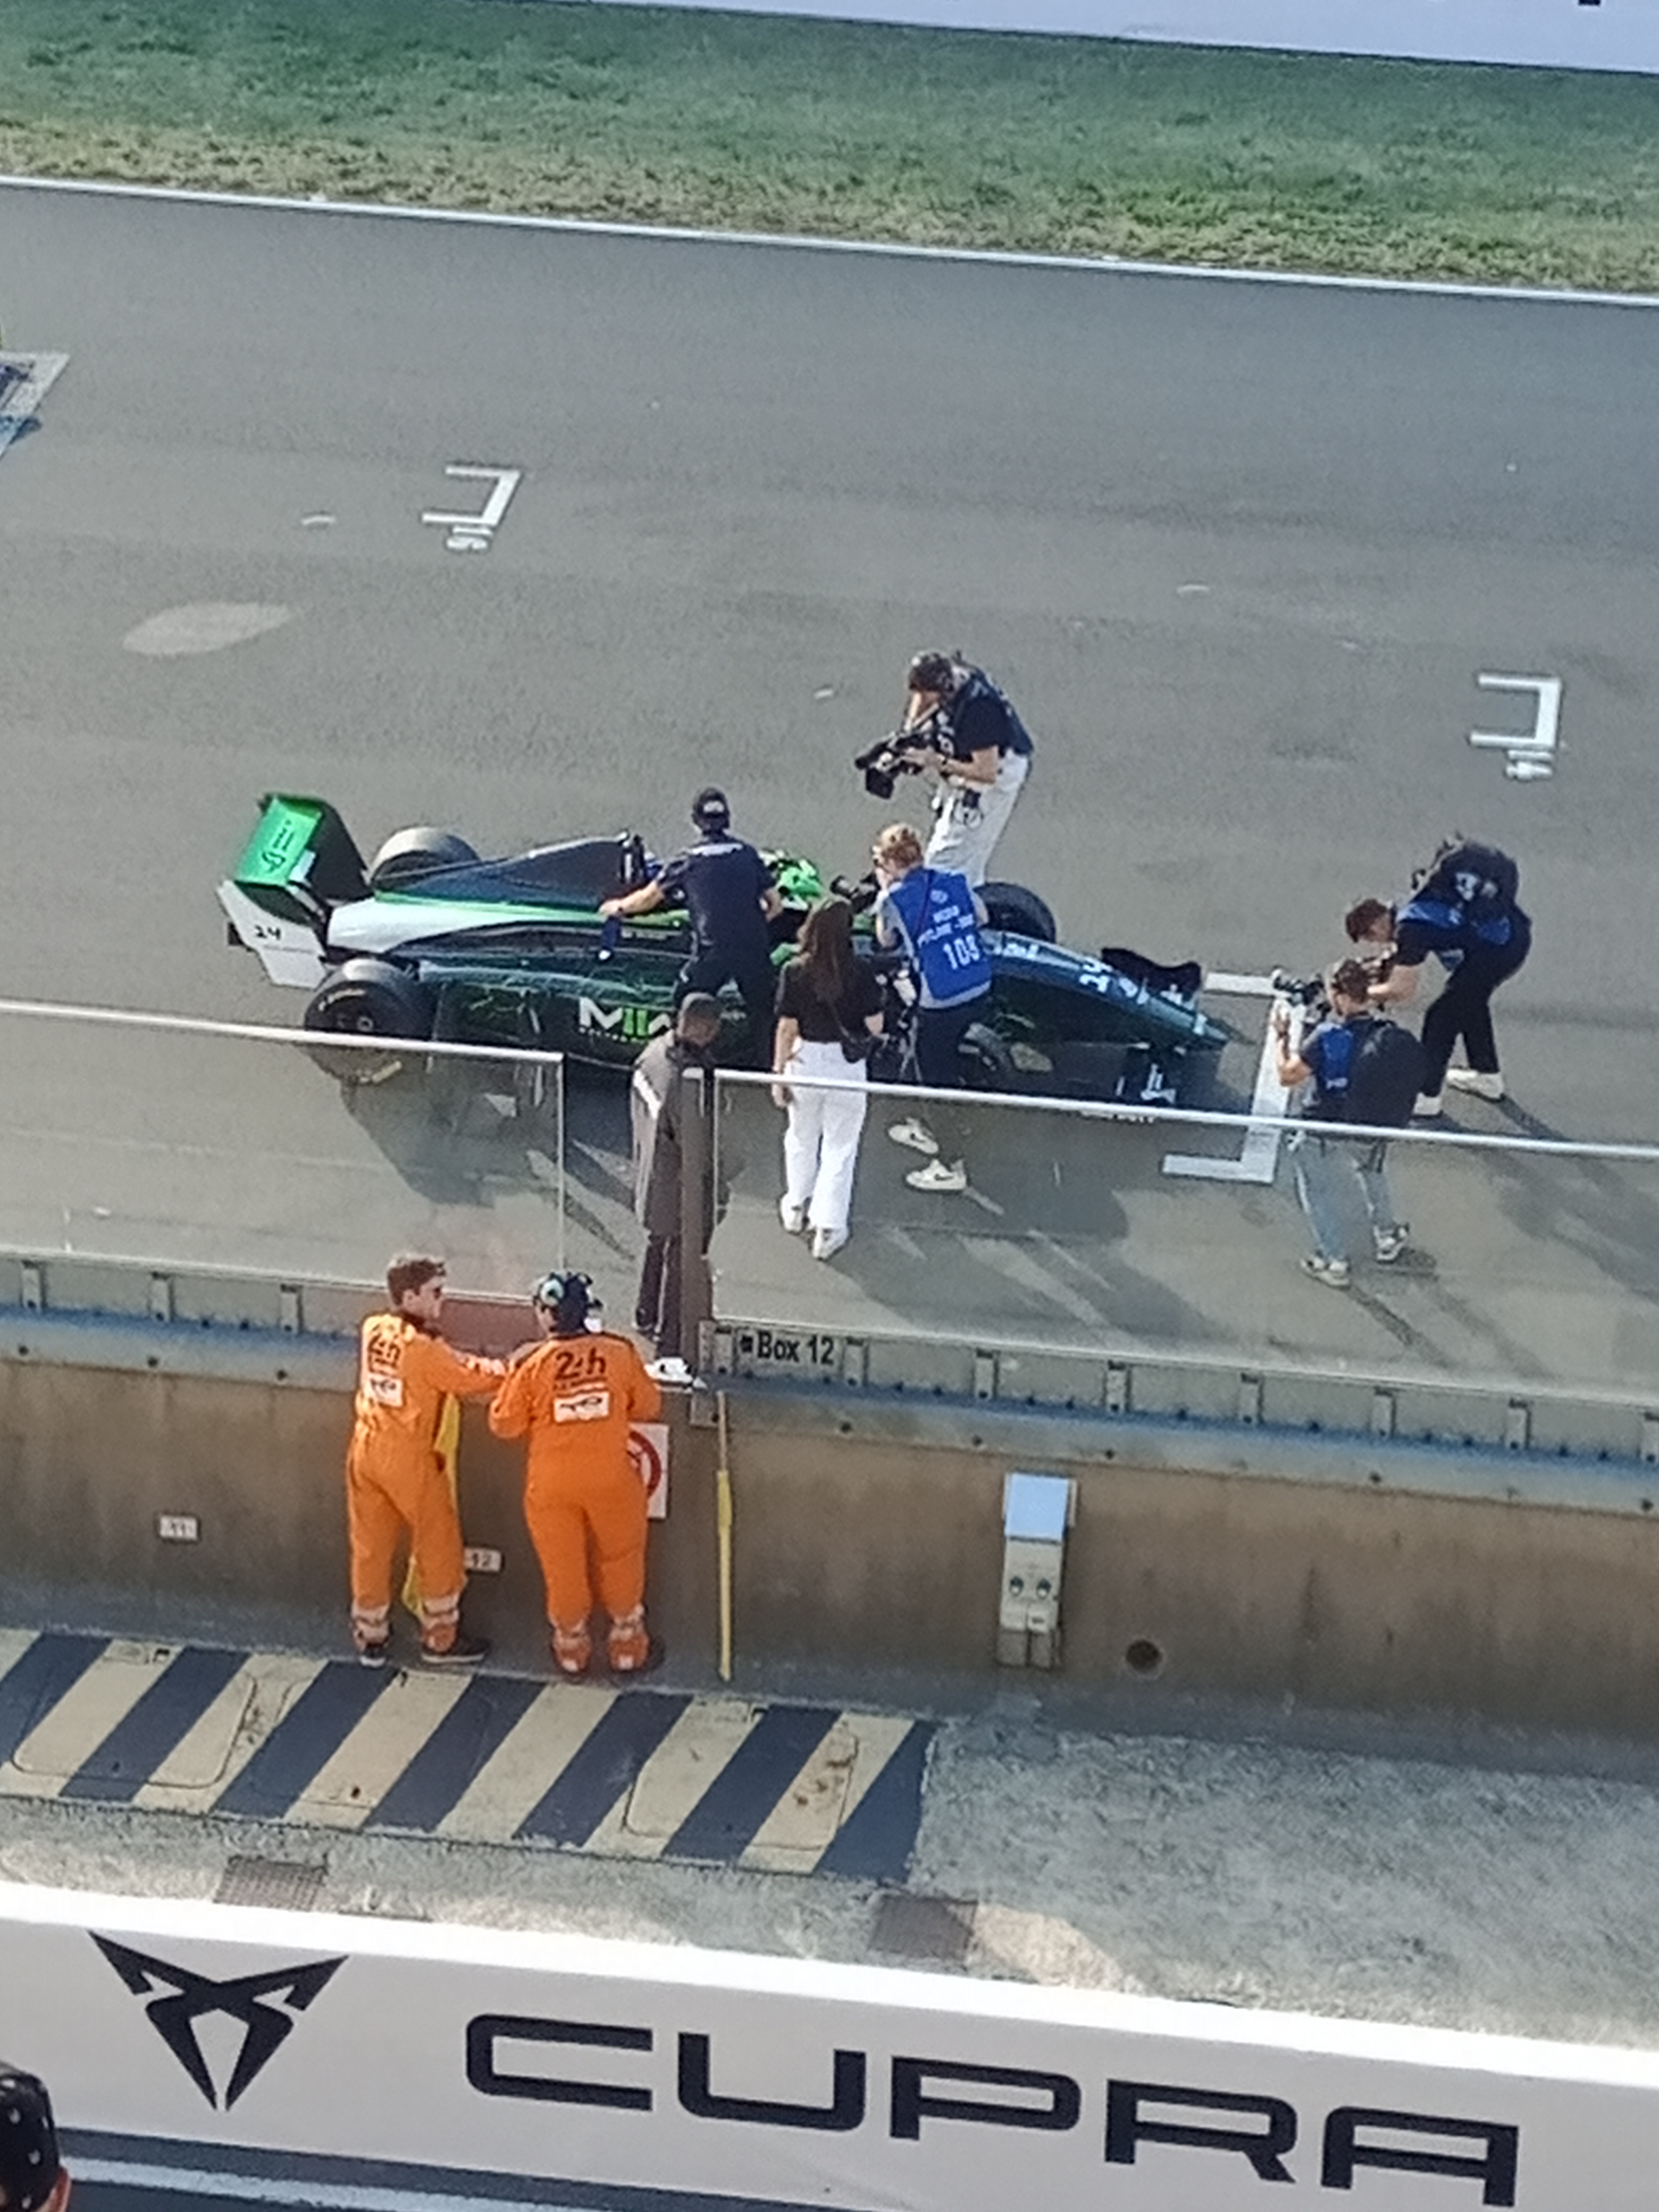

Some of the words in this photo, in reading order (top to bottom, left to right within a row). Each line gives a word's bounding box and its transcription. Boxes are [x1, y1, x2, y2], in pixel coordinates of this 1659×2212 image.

[255, 925, 281, 941] 24
[757, 1331, 800, 1362] Box
[808, 1335, 834, 1365] 12
[466, 2014, 1519, 2207] CUPRA
